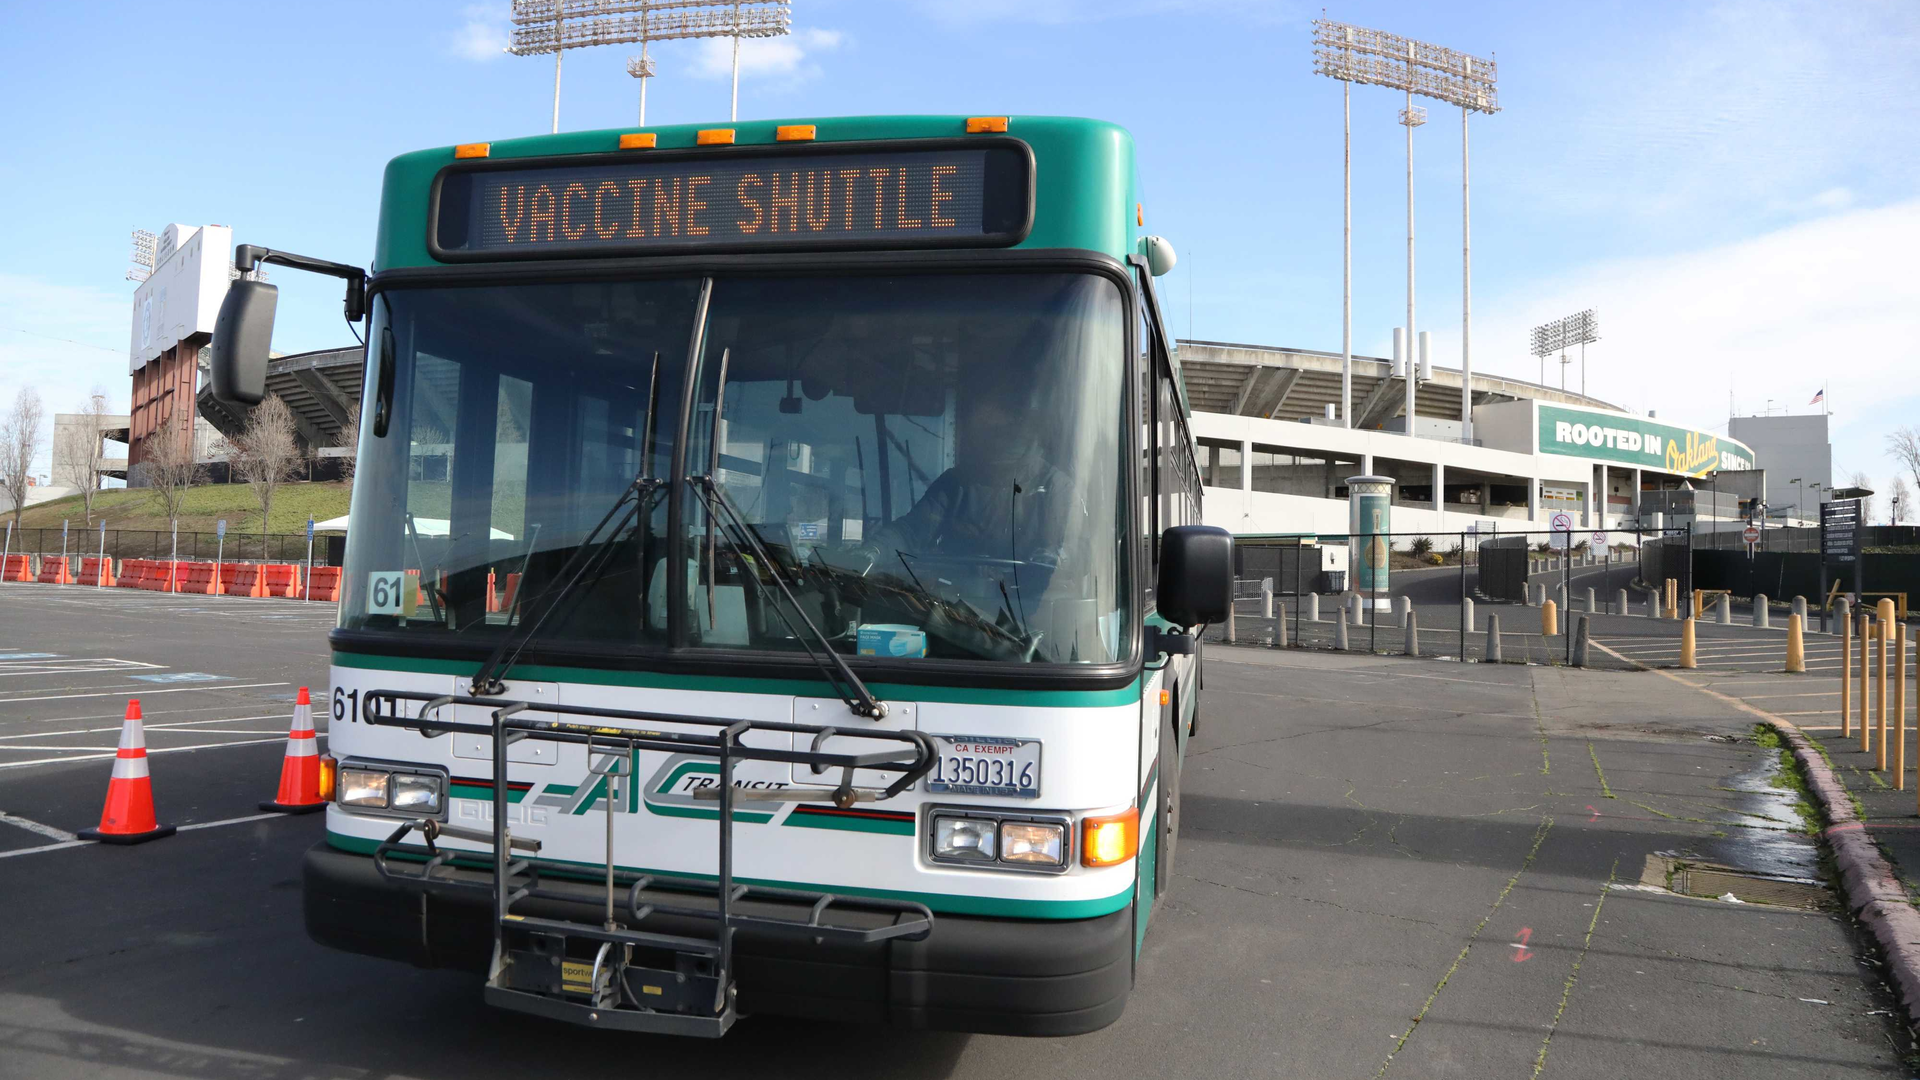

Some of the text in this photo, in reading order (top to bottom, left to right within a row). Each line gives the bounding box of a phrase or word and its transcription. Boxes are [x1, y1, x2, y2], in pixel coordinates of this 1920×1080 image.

[499, 165, 957, 243] VACCINE SHUTTLE
[1555, 420, 1642, 452] ROOTED
[1644, 433, 1662, 456] IN
[1666, 430, 1719, 475] Oakland
[372, 576, 401, 608] 61
[955, 743, 1014, 755] CA EXEMPT
[933, 755, 1034, 788] 1350316
